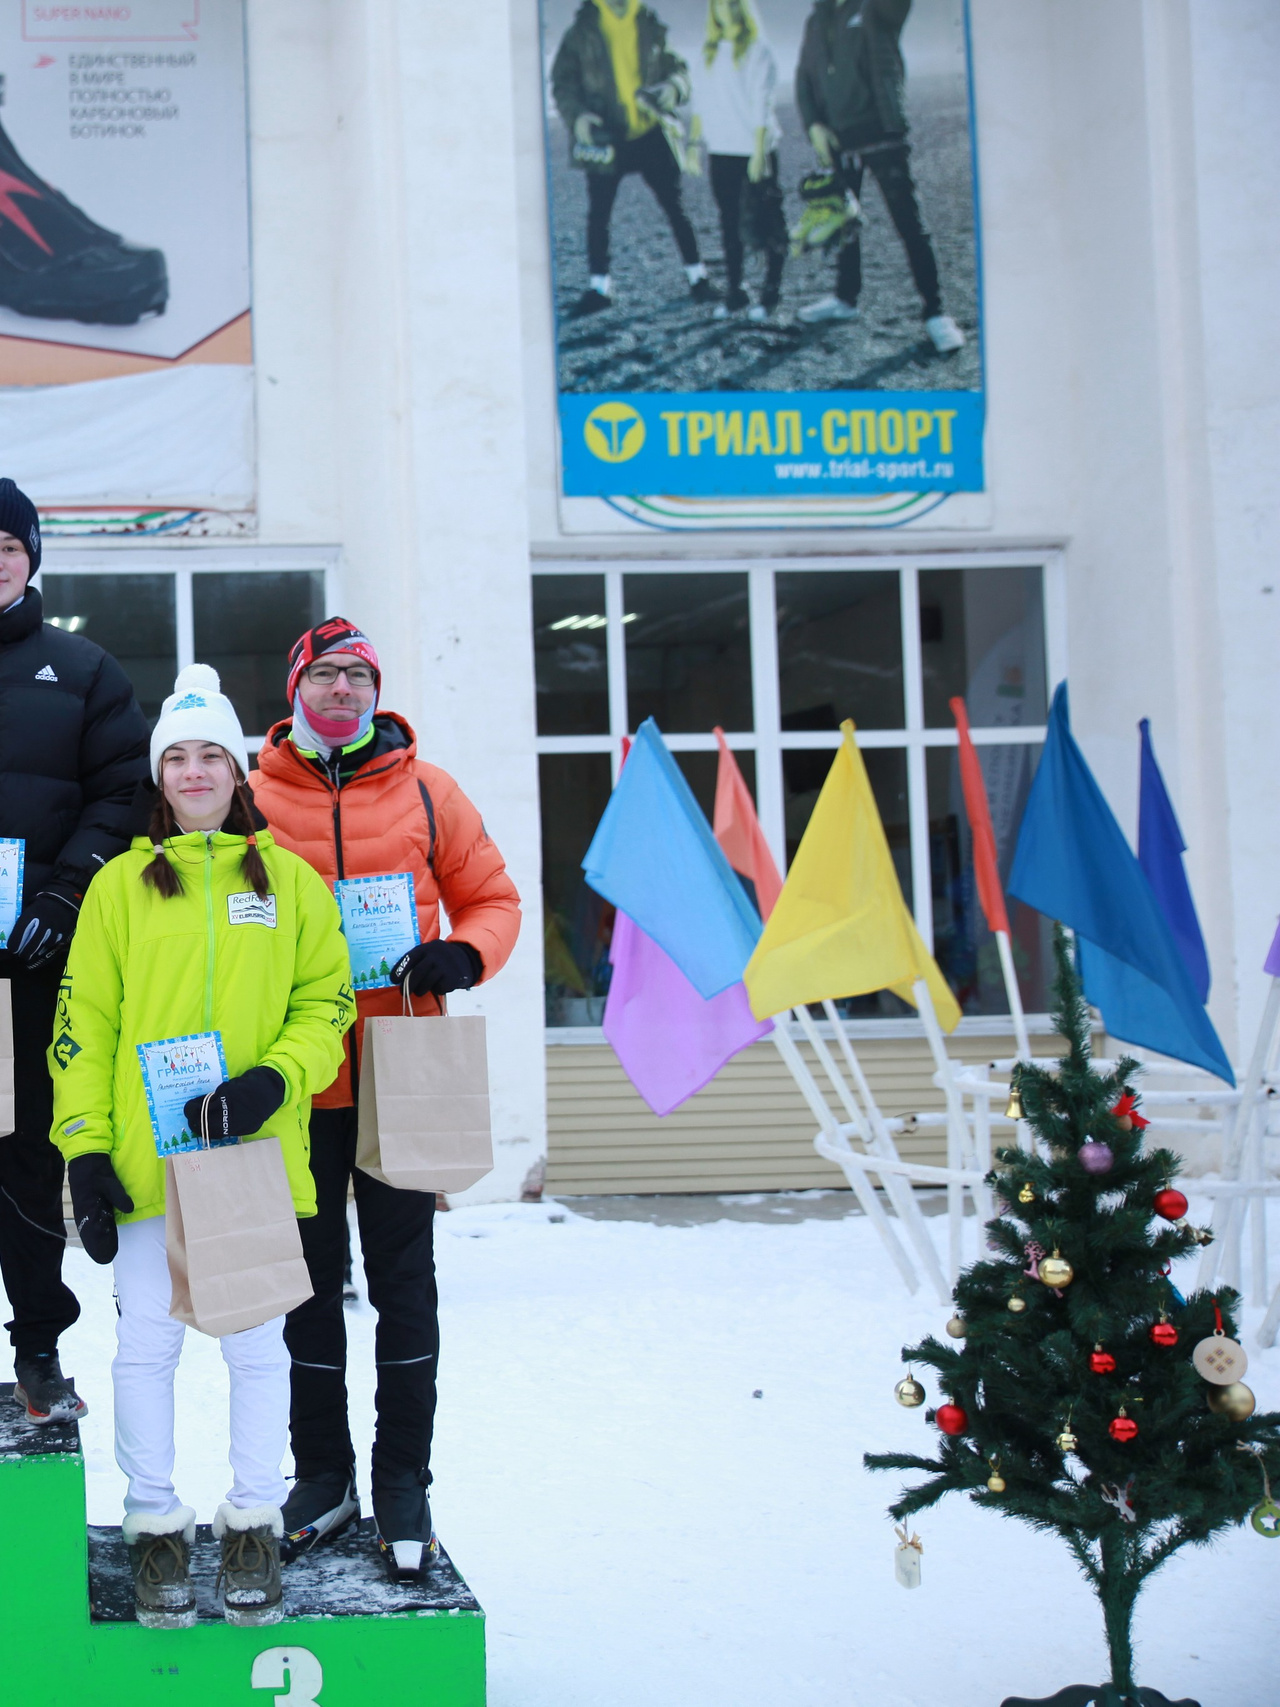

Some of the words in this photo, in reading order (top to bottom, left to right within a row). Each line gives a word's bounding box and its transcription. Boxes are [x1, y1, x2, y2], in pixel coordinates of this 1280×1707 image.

[33, 6, 81, 21] SUPER
[69, 52, 197, 68] ЕДИНСТВЕННЫЙ
[83, 72, 124, 84] МИРЕ
[70, 89, 172, 104] ПОЛНОСТЬЮ
[70, 105, 179, 121] КАРБОНОВЫЙ
[70, 125, 146, 139] БОТИНОК
[775, 459, 954, 482] www.trial-sport.ru
[35, 674, 58, 682] adidas
[233, 895, 263, 904] RedFo
[350, 903, 401, 918] ГРАМОТА
[157, 1062, 211, 1078] ГРАМОТА
[250, 1646, 324, 1707] 3
